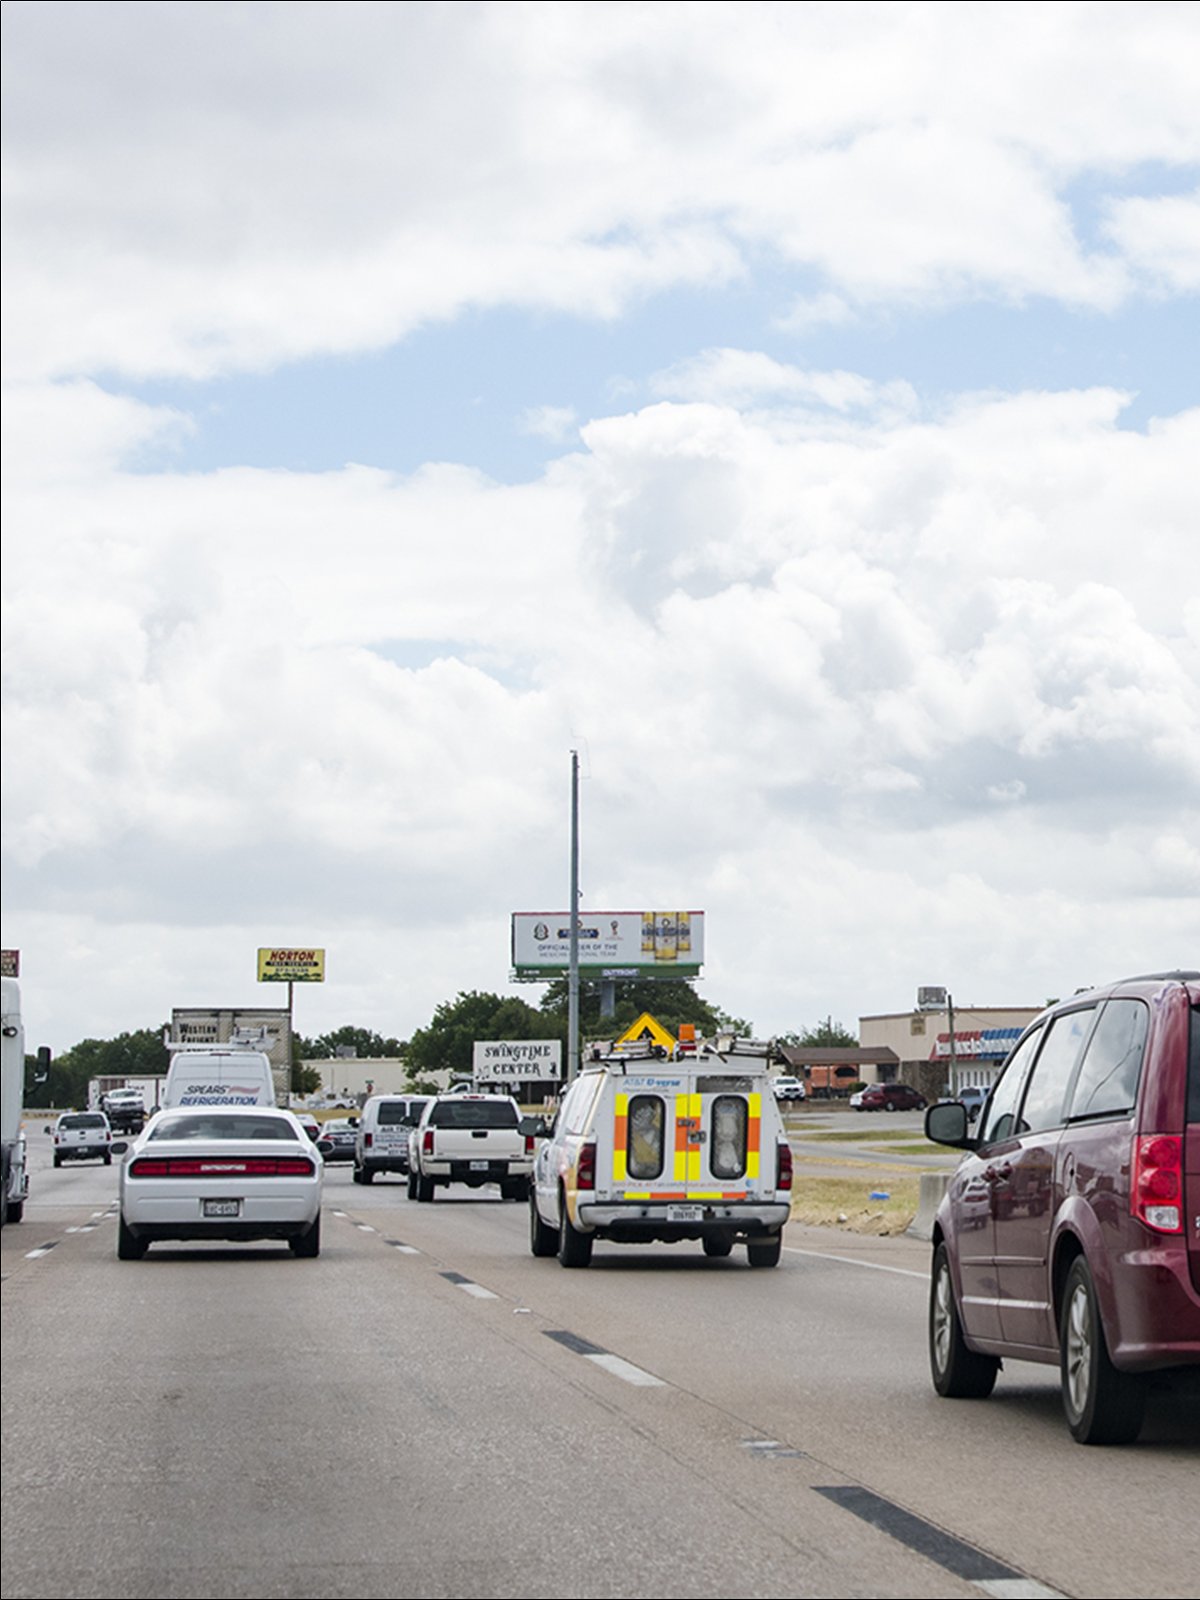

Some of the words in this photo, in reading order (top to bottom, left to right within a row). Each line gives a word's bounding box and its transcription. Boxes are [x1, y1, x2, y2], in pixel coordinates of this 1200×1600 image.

[270, 951, 315, 961] HORTON
[179, 1023, 217, 1034] WESTERN
[181, 1034, 215, 1043] FREIGHT
[484, 1043, 551, 1061] SWINGTIME
[493, 1062, 541, 1077] CENTER
[623, 1078, 645, 1086] AT&T
[646, 1078, 681, 1086] U-verse
[180, 1096, 258, 1105] REFRIGERATION
